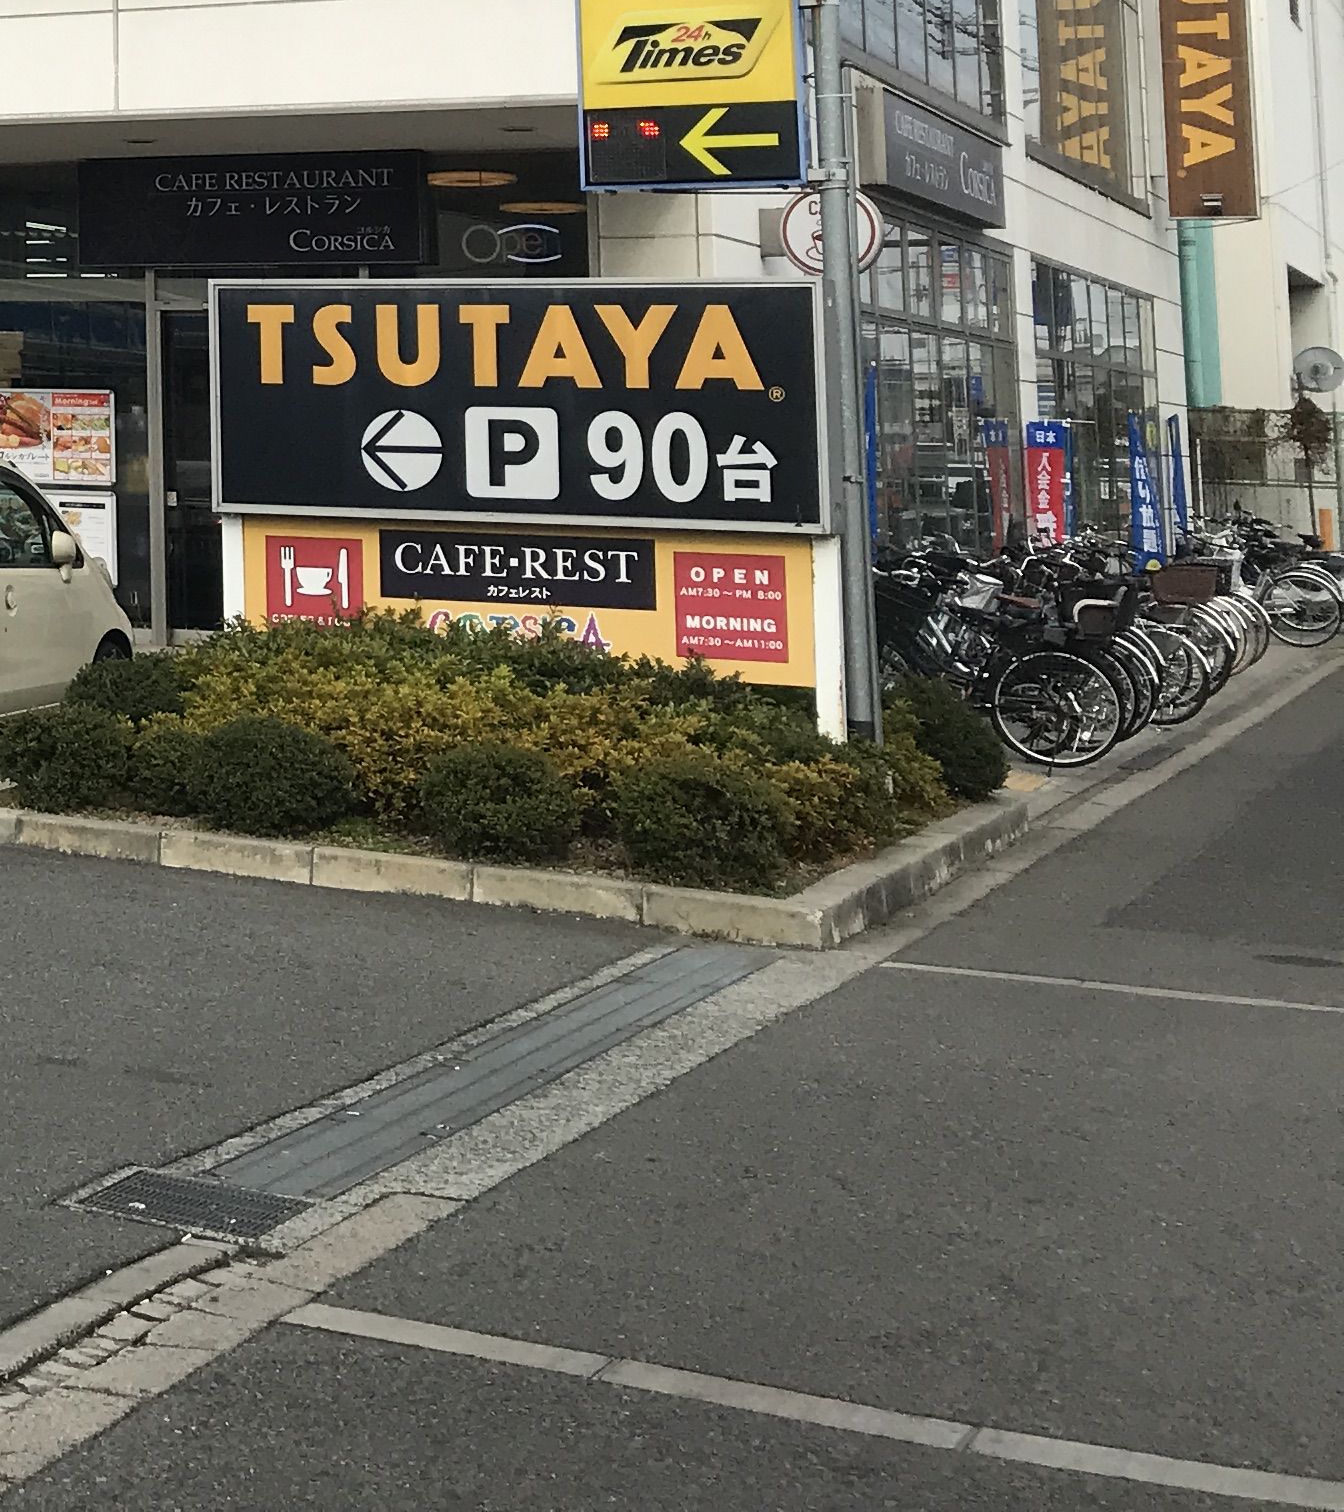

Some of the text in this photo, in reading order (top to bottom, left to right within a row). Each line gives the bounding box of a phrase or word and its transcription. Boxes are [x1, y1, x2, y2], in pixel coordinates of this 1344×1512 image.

[671, 25, 712, 43] 24h
[613, 25, 754, 73] Times
[155, 169, 393, 191] CAFE RESTAURANT
[289, 229, 395, 252] CORSICA
[247, 304, 765, 390] TSUTAYA
[586, 410, 778, 503] 90台
[690, 567, 769, 585] OPEN
[487, 584, 551, 599] カフェレスト
[686, 615, 776, 633] MORNING
